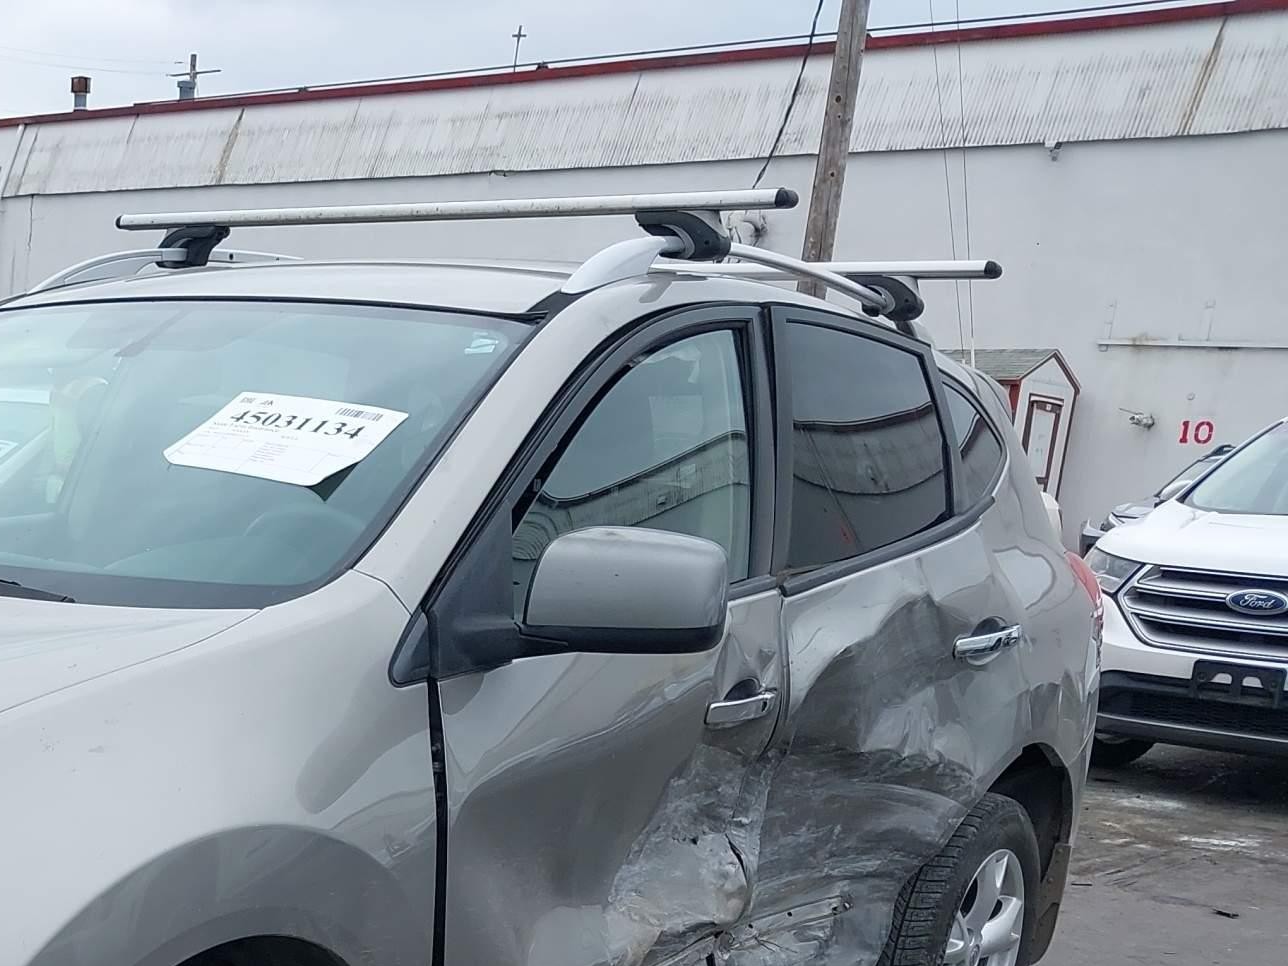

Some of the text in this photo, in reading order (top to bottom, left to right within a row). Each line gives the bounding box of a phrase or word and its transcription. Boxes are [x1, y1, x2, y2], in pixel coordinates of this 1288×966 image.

[231, 410, 365, 439] 45031134
[1178, 420, 1213, 444] 10
[1240, 594, 1274, 608] Ford
